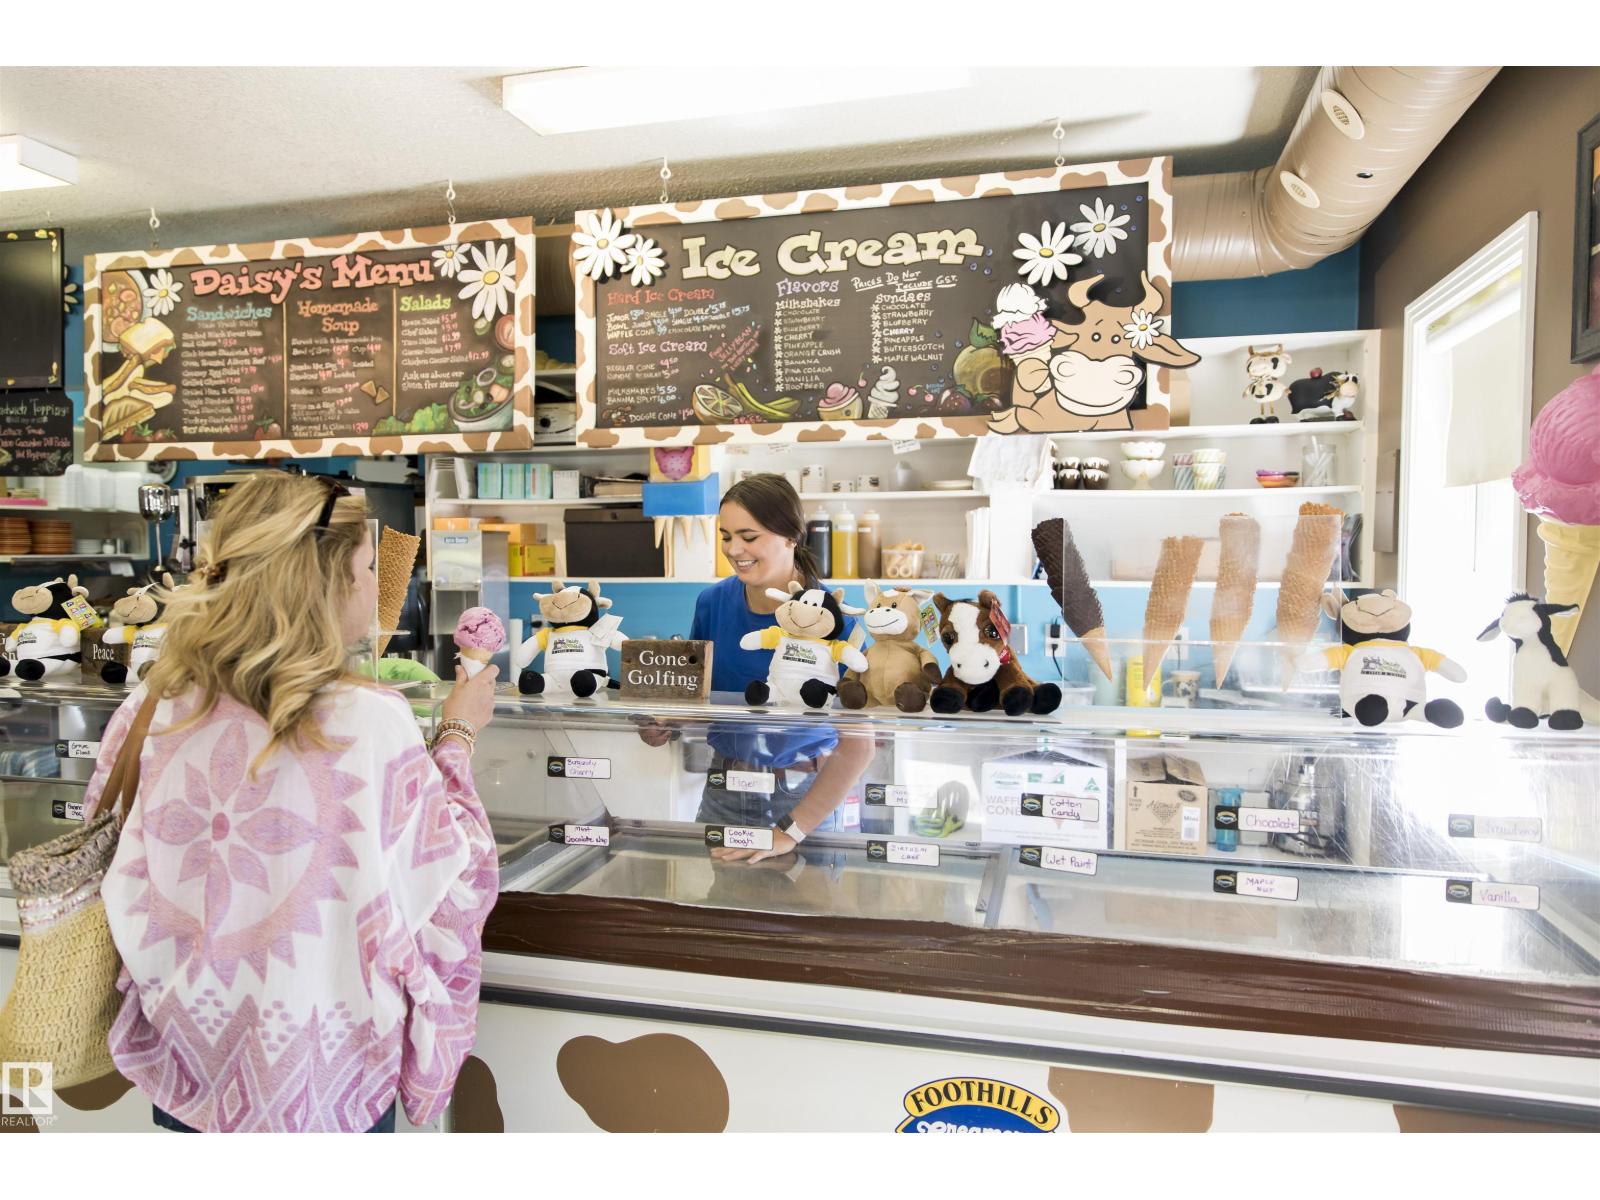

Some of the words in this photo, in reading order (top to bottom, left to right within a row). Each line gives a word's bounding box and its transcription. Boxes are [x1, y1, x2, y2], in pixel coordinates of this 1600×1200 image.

[681, 234, 762, 280] Ice
[777, 228, 984, 276] Cream
[189, 262, 323, 304] Daisy's
[330, 254, 435, 289] Menu
[776, 278, 839, 297] Flavors
[400, 294, 452, 312] Salads
[607, 290, 640, 306] Hard
[644, 290, 663, 302] Ice
[668, 288, 715, 301] Cream
[775, 297, 841, 310] Milkshakes
[187, 302, 272, 321] Sandwiches
[297, 297, 378, 317] Homemade
[882, 310, 934, 320] STRAWBERRY
[322, 317, 360, 337] Soup
[883, 318, 928, 327] BLUEBERRY
[784, 332, 814, 341] CHERRY
[882, 328, 915, 336] CHERRY
[784, 342, 823, 350] PINEAPPLE
[883, 336, 925, 344] PINEAPPLE
[608, 342, 634, 355] Soft
[638, 342, 656, 354] Ice
[660, 340, 708, 352] Cream
[784, 350, 816, 358] ORANGE
[818, 348, 842, 356] CRUSH
[884, 344, 945, 353] BUTTERSCOTCH
[784, 358, 820, 366] BANANA
[884, 354, 909, 362] MAPLE
[911, 354, 944, 362] WALNUT
[803, 366, 832, 374] COLADA
[607, 387, 656, 396] MILKSHAKES
[606, 396, 635, 405] BANANA
[630, 412, 656, 424] DOGGIE
[658, 411, 677, 420] CONE
[93, 644, 115, 661] Peace
[638, 650, 688, 667] Gone
[628, 670, 698, 690] Golfing
[728, 776, 759, 790] Tiger
[1049, 798, 1082, 809] Cotton
[1052, 807, 1080, 820] Candy
[1245, 814, 1298, 830] Chocolate
[1046, 853, 1066, 865] Wet
[1070, 856, 1094, 869] Paint
[1480, 888, 1519, 904] Vanilla
[910, 1080, 1052, 1125] FOOTHILLS
